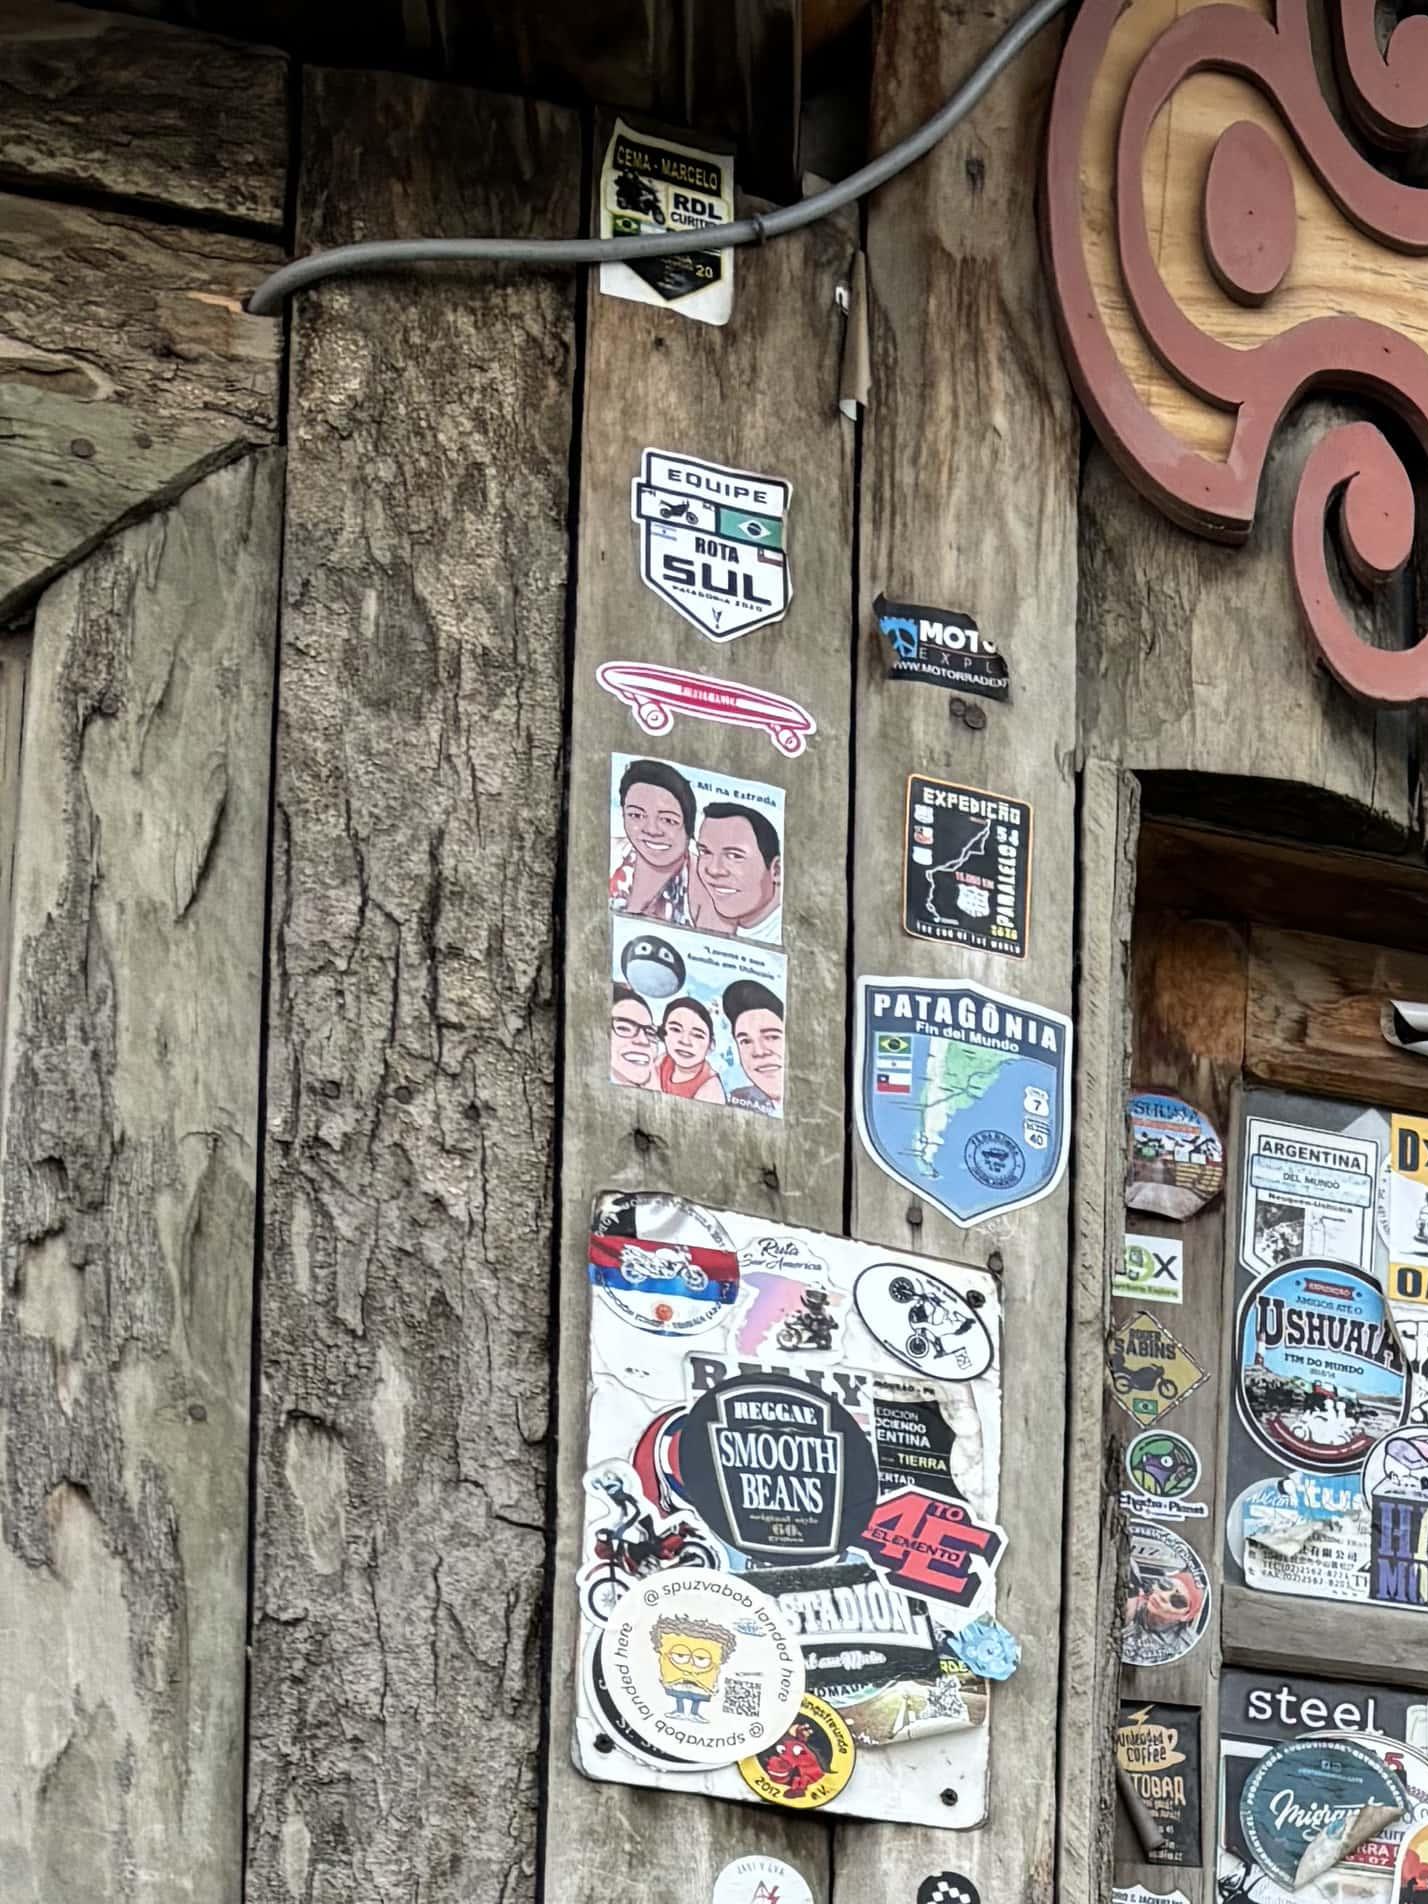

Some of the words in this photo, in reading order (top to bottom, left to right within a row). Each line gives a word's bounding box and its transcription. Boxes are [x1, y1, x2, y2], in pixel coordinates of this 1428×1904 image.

[615, 145, 652, 171] CEMA
[661, 157, 718, 192] MARCELO
[673, 192, 722, 220] RDL
[668, 469, 768, 504] EQUIPE
[695, 538, 740, 564] ROTA
[663, 556, 772, 606] SUL
[923, 787, 1021, 824] EXPEDIÇÃO
[874, 993, 1057, 1053] PATAGÔNIA
[916, 1021, 939, 1035] Fin
[943, 1024, 966, 1042] del
[970, 1030, 1019, 1054] Mundo
[1261, 1139, 1363, 1169] ARGENTINA
[1282, 1172, 1301, 1186] DEL
[1304, 1175, 1340, 1190] MUNDO
[760, 1237, 799, 1257] Ruta
[1258, 1296, 1398, 1356] USHUAIA
[1113, 1339, 1177, 1362] SABINS
[734, 1400, 816, 1424] REGGAE
[720, 1429, 836, 1473] SMOOTH
[897, 1453, 946, 1471] TIERRA
[741, 1471, 823, 1514] BEANS
[934, 1502, 965, 1520] TO
[871, 1529, 960, 1562] ELEMENTO
[1247, 1688, 1383, 1733] steel
